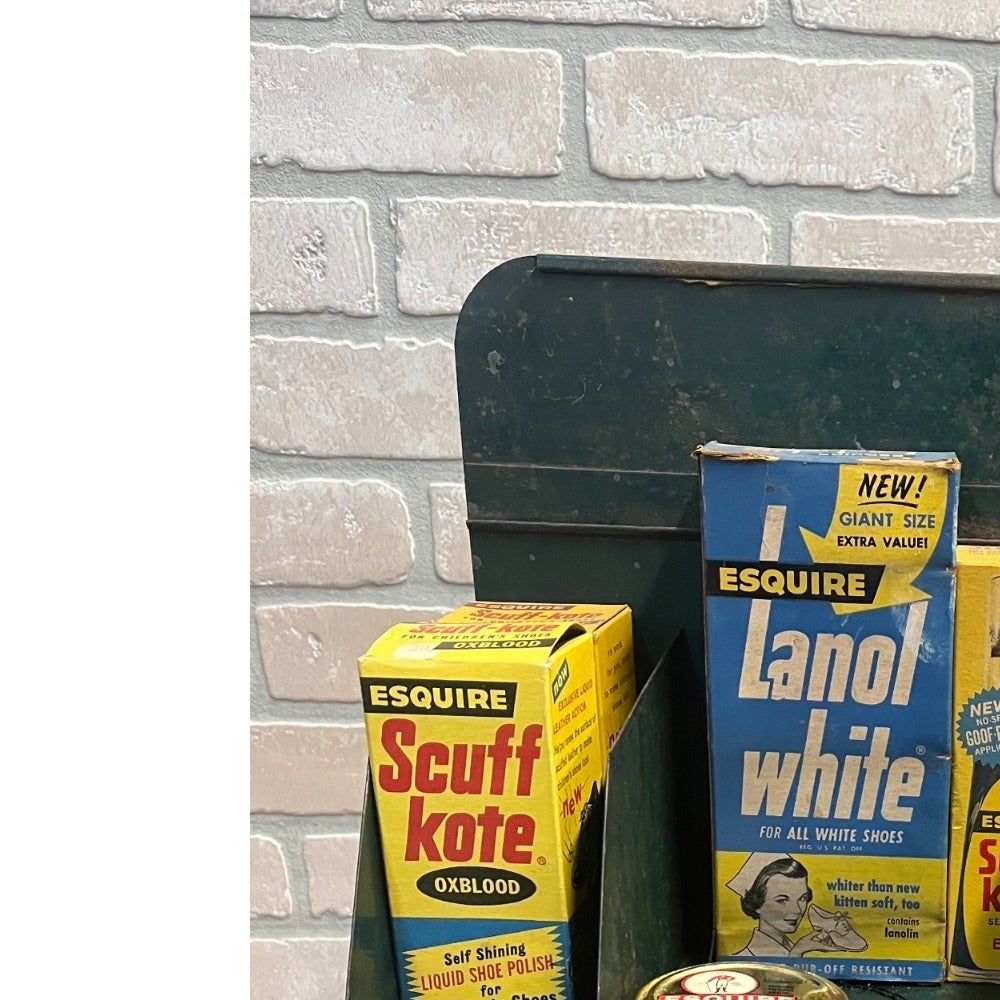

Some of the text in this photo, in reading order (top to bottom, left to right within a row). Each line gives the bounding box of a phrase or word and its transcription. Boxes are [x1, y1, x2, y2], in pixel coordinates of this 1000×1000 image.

[858, 473, 928, 500] NEW!
[839, 512, 936, 529] GIANT SIZE
[837, 536, 928, 549] EXTRA VALUE!
[719, 567, 866, 597] ESQUIRE
[738, 505, 929, 706] Lanol
[408, 623, 561, 634] Scuff-kote
[452, 640, 542, 649] OXBLOOD
[369, 685, 508, 710] ESQUIRE
[378, 718, 544, 797] Scuff
[741, 708, 925, 822] white
[404, 796, 537, 864] kote
[760, 826, 904, 844] FOR ALL WHITE SHOES
[434, 877, 521, 895] OXBLOOD
[827, 879, 920, 894] whiter than new
[834, 895, 920, 910] kitten soft, too
[887, 916, 920, 926] contains
[885, 927, 919, 938] lanolin
[444, 943, 526, 966] Self Shining
[421, 955, 554, 991] LIQUID SHOE POLISH
[851, 964, 914, 976] RESISTANT
[481, 985, 502, 997] for
